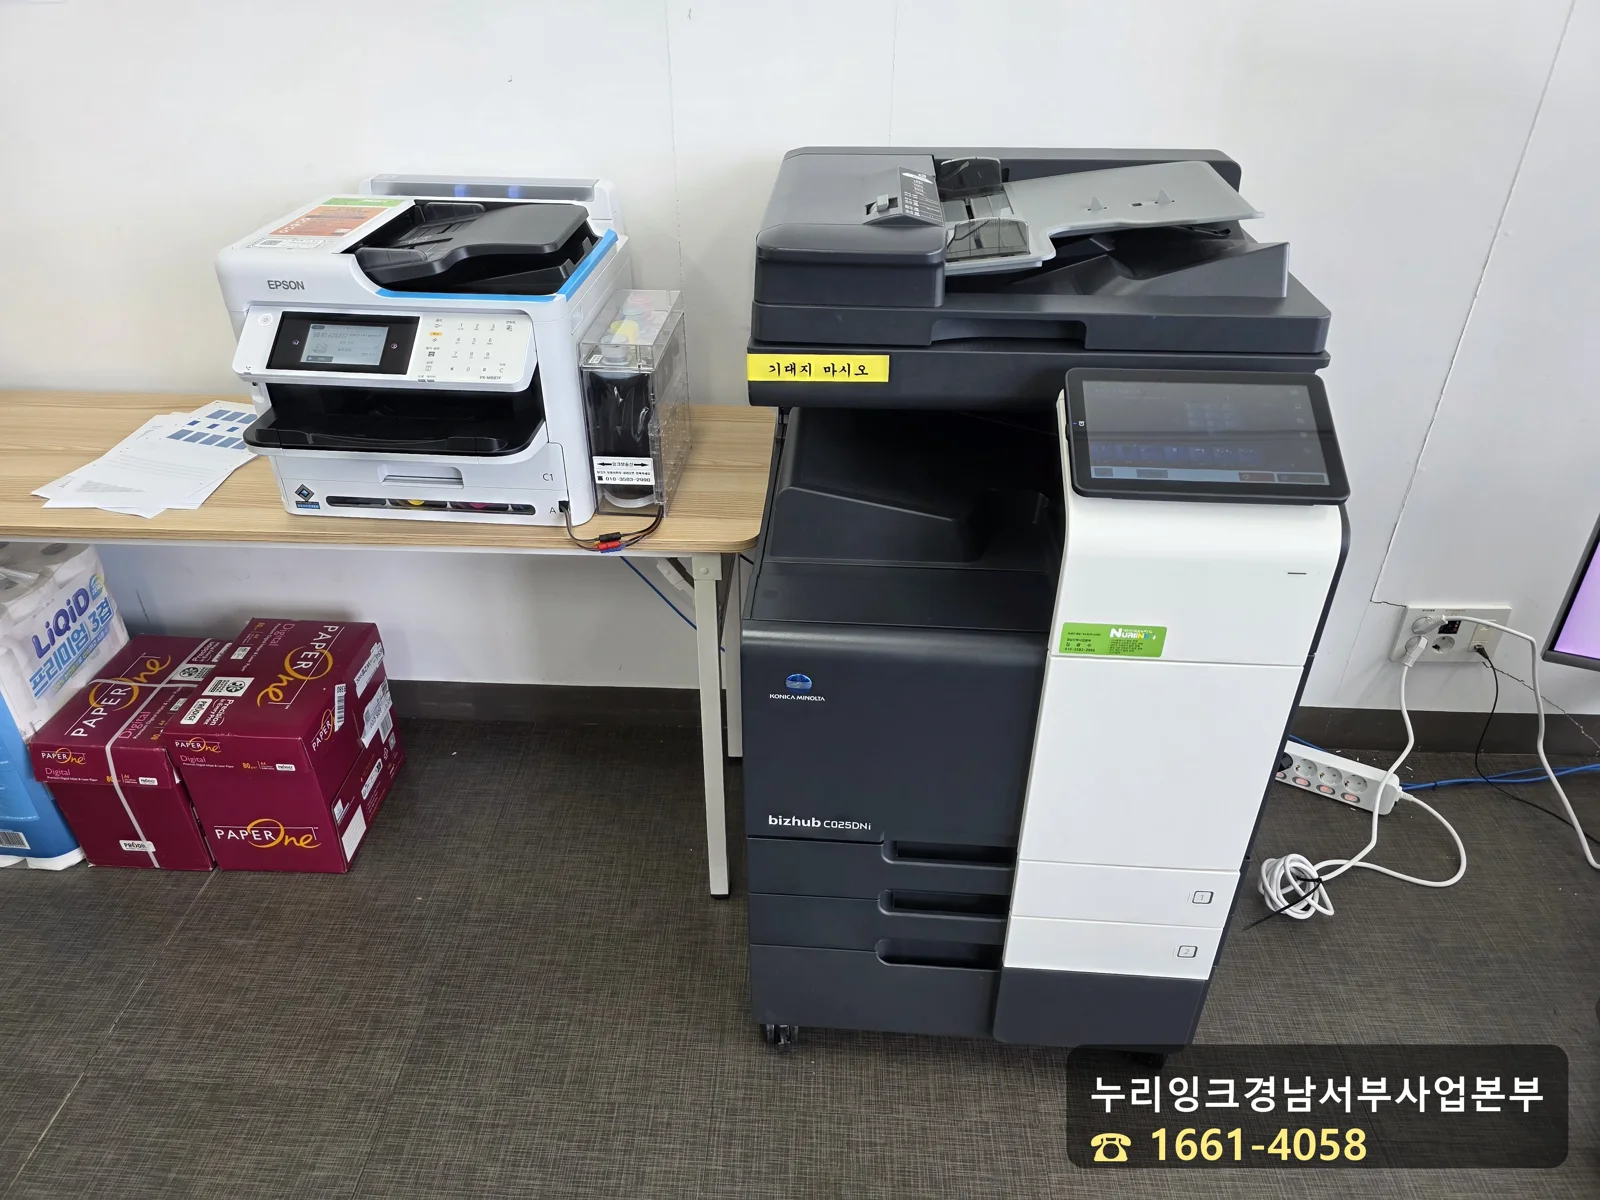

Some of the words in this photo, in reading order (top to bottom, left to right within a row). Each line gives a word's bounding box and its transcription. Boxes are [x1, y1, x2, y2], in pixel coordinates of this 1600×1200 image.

[267, 280, 305, 290] EPSON
[768, 362, 812, 377] 기대지
[823, 362, 869, 377] 마시오
[542, 473, 554, 481] C1
[550, 506, 557, 514] A
[32, 588, 90, 658] LiQiD
[269, 623, 295, 646] Digital
[29, 622, 90, 697] 프리미엄
[88, 597, 114, 632] 3겹
[796, 694, 826, 702] MINOLTA
[118, 711, 151, 738] Digital
[180, 755, 206, 764] Digital
[45, 768, 71, 778] Digital
[768, 814, 822, 828] bizhub
[823, 820, 872, 831] C025DNi
